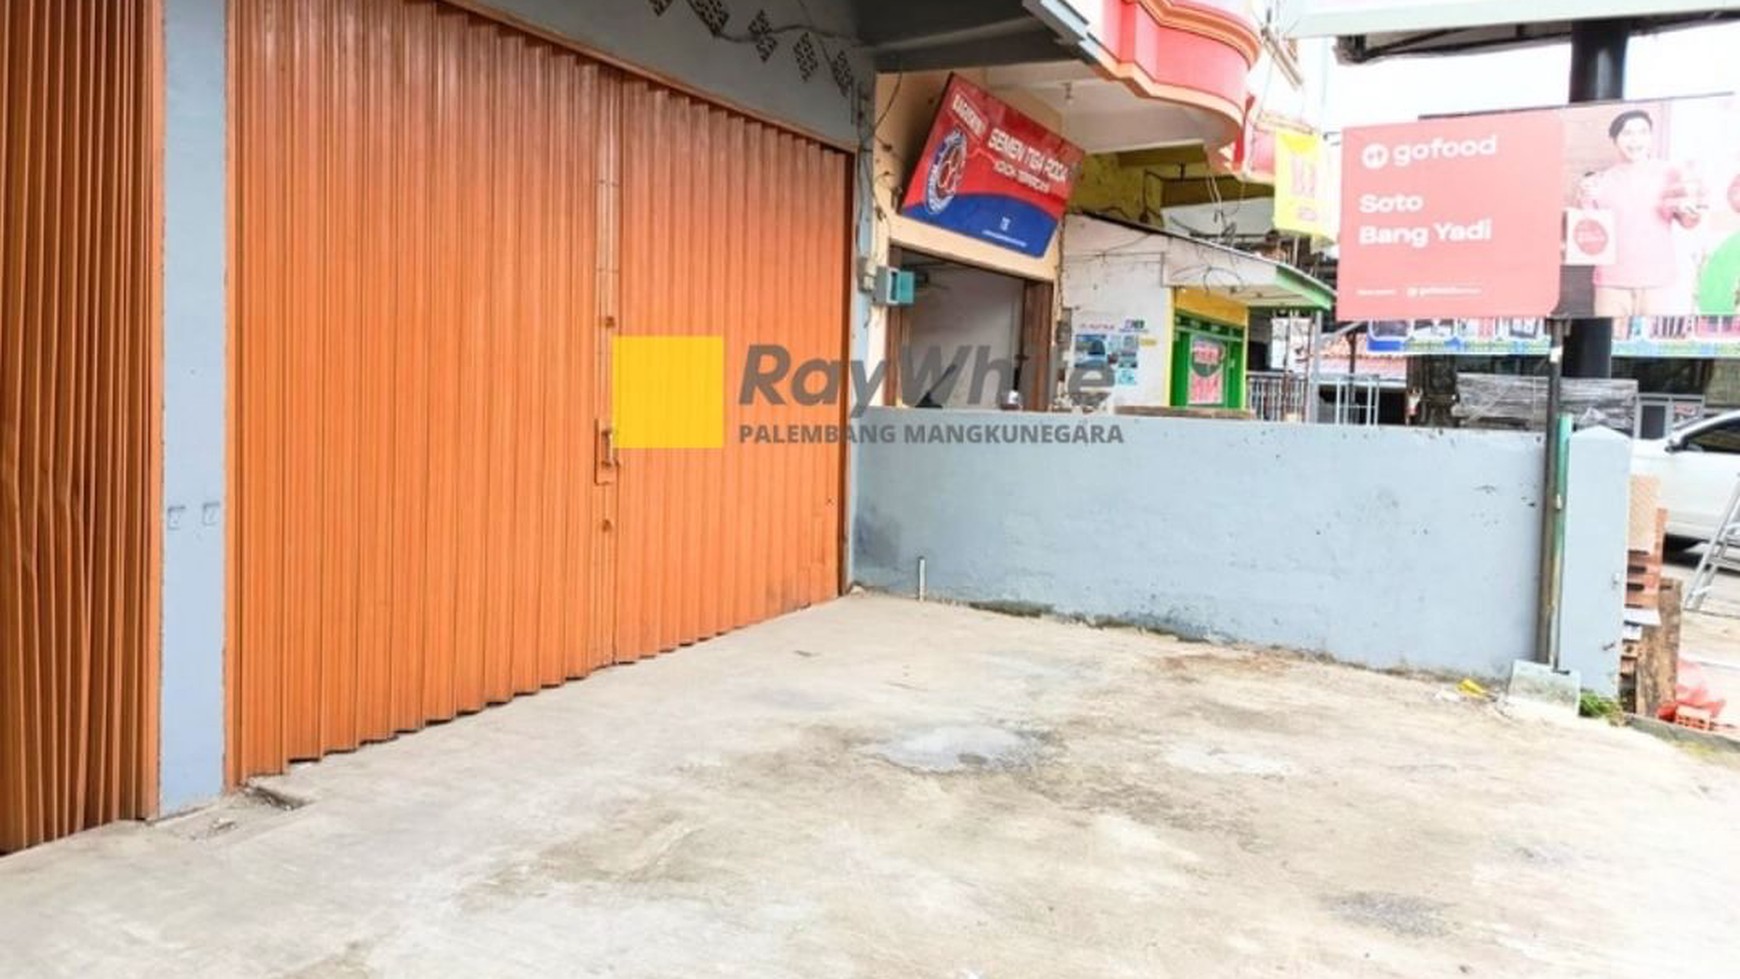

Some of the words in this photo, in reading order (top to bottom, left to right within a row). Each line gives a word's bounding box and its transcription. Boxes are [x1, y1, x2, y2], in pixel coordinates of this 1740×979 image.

[1393, 135, 1498, 167] gofood
[1358, 194, 1424, 213] Soto
[1358, 225, 1429, 248] Bang
[1433, 219, 1493, 241] Yadi
